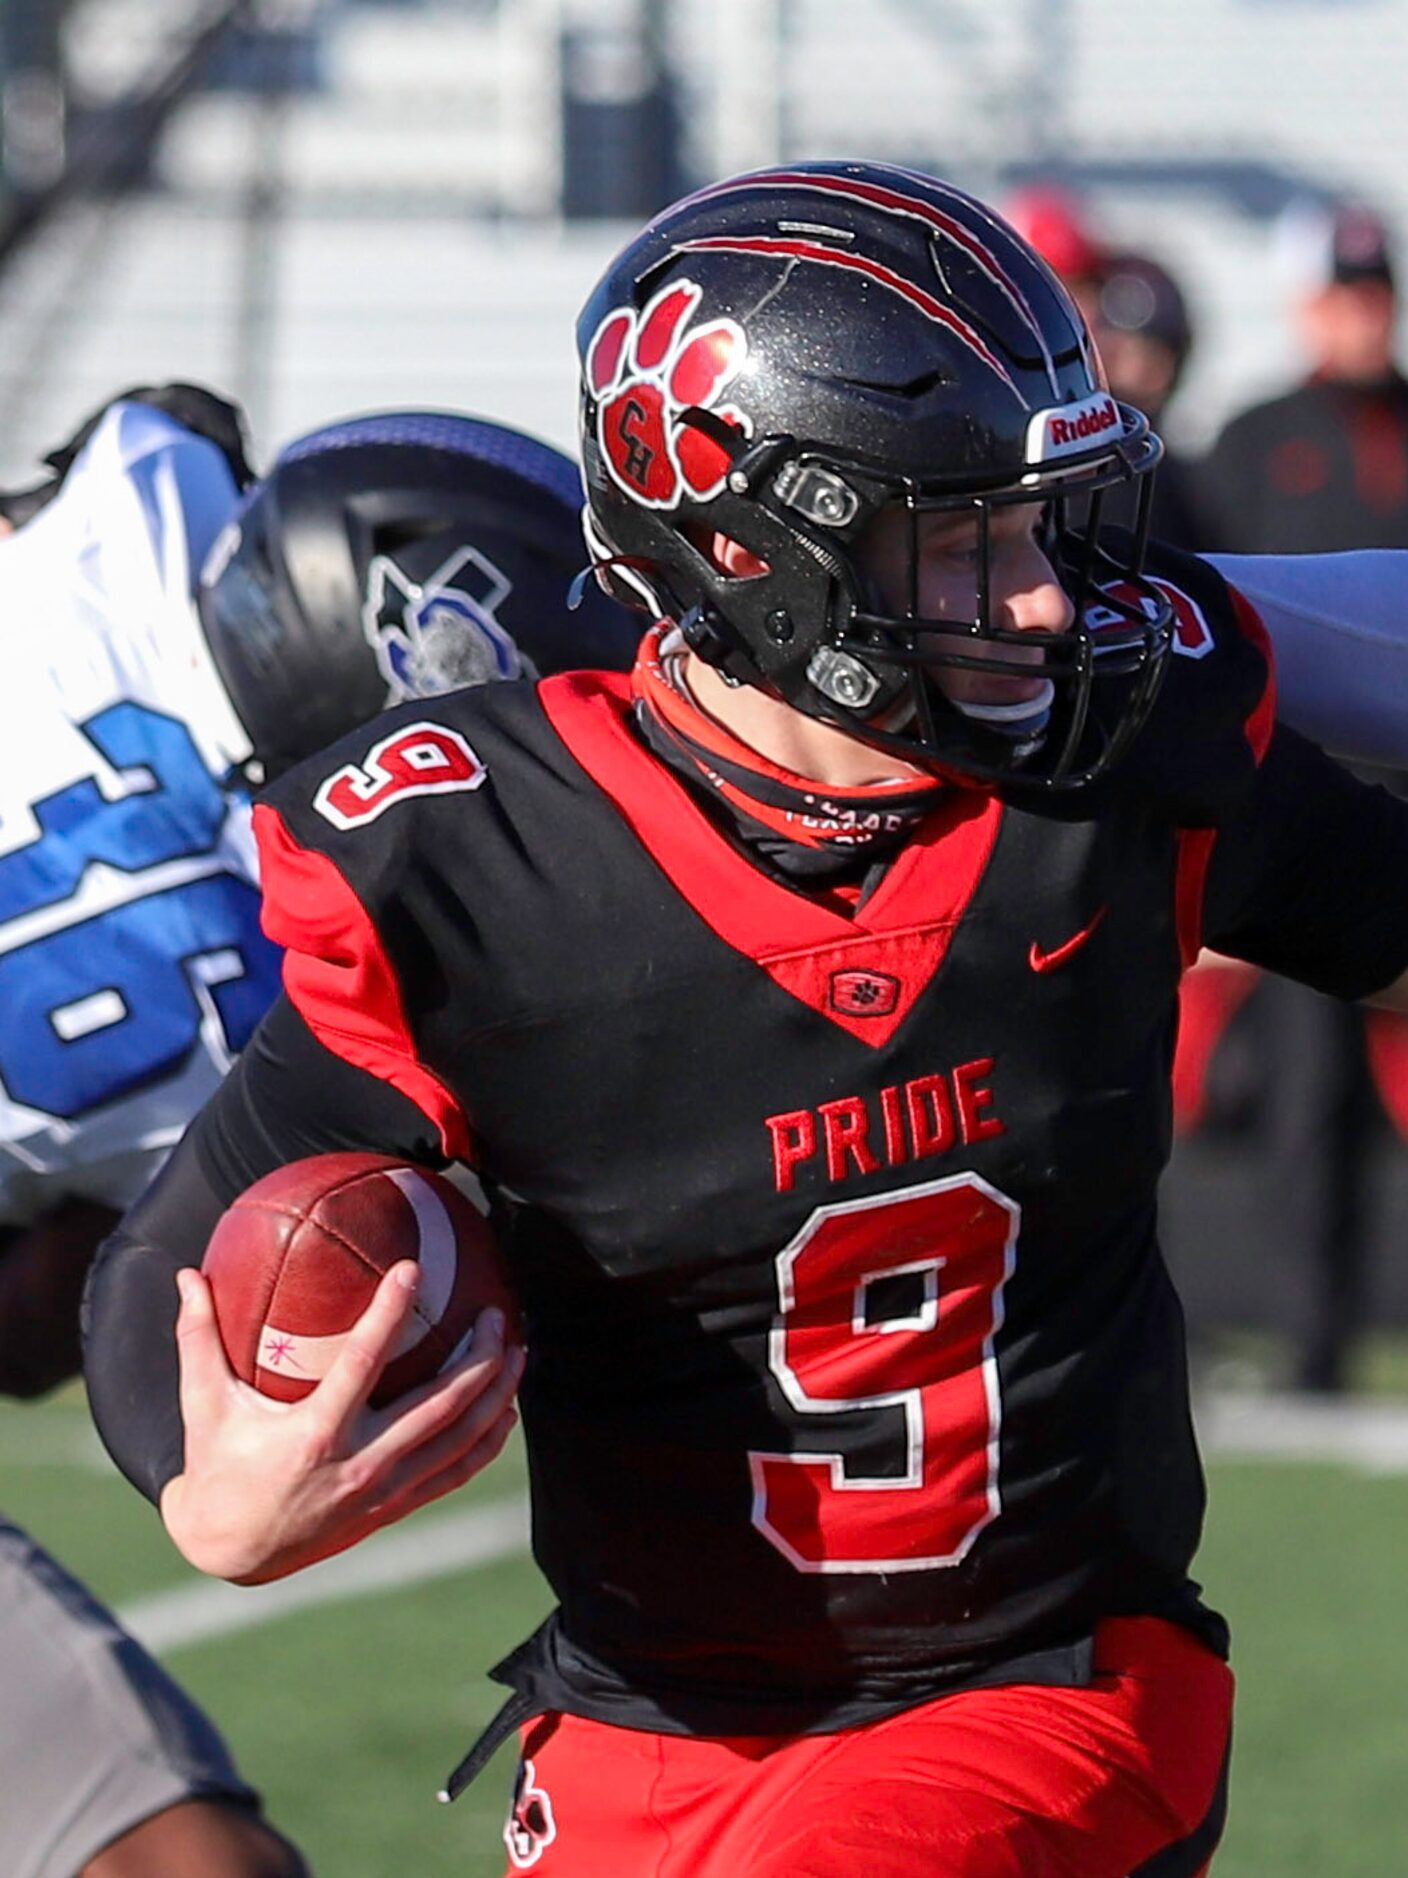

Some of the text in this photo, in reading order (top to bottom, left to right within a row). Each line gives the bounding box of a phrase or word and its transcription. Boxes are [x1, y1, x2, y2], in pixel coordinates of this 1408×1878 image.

[1048, 398, 1118, 447] Riddell
[312, 719, 488, 831] 9
[764, 1057, 1007, 1193] PRIDE
[747, 1170, 1022, 1573] 9
